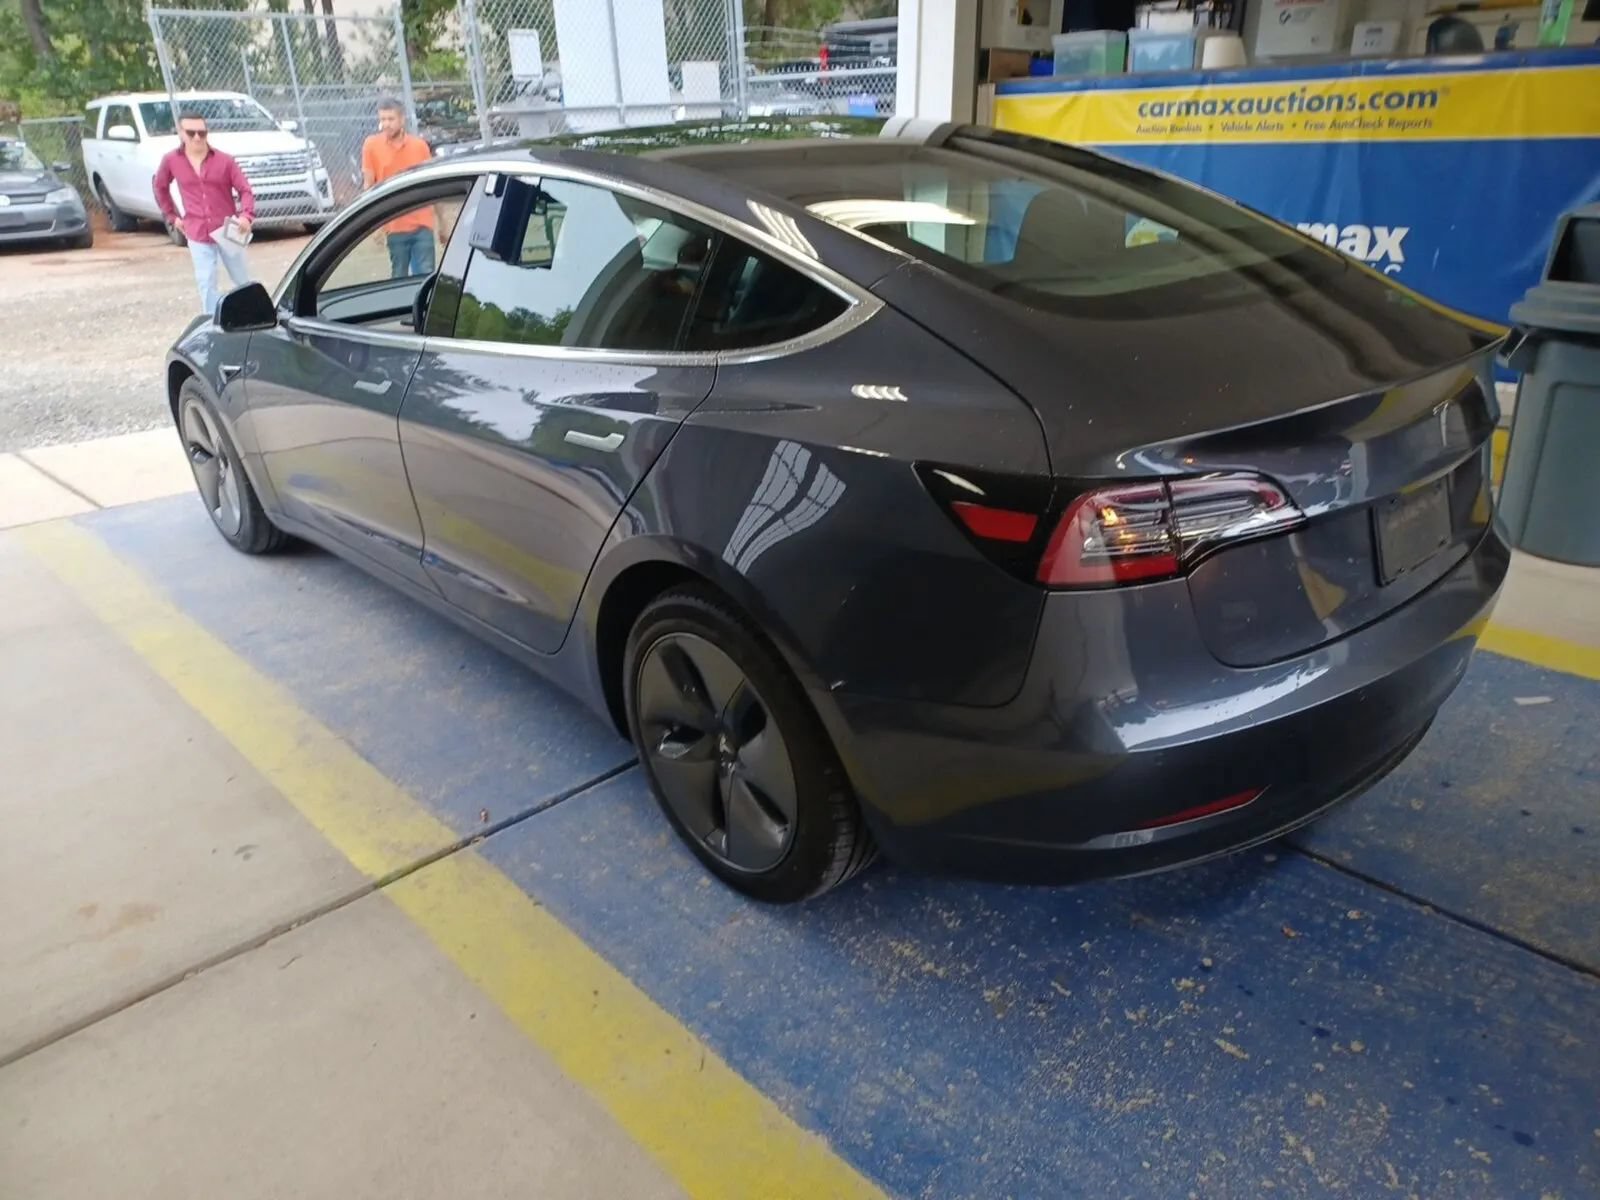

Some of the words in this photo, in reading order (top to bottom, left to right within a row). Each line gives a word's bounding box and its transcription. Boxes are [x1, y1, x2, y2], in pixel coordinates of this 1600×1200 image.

[1138, 87, 1438, 118] carmaxauctions.com
[1136, 123, 1167, 134] Auction
[1221, 121, 1252, 132] Vehicle
[1256, 119, 1284, 131] Alerts
[1304, 119, 1326, 131] Free
[1329, 117, 1384, 131] AutoCheck
[1388, 117, 1433, 131] Reports
